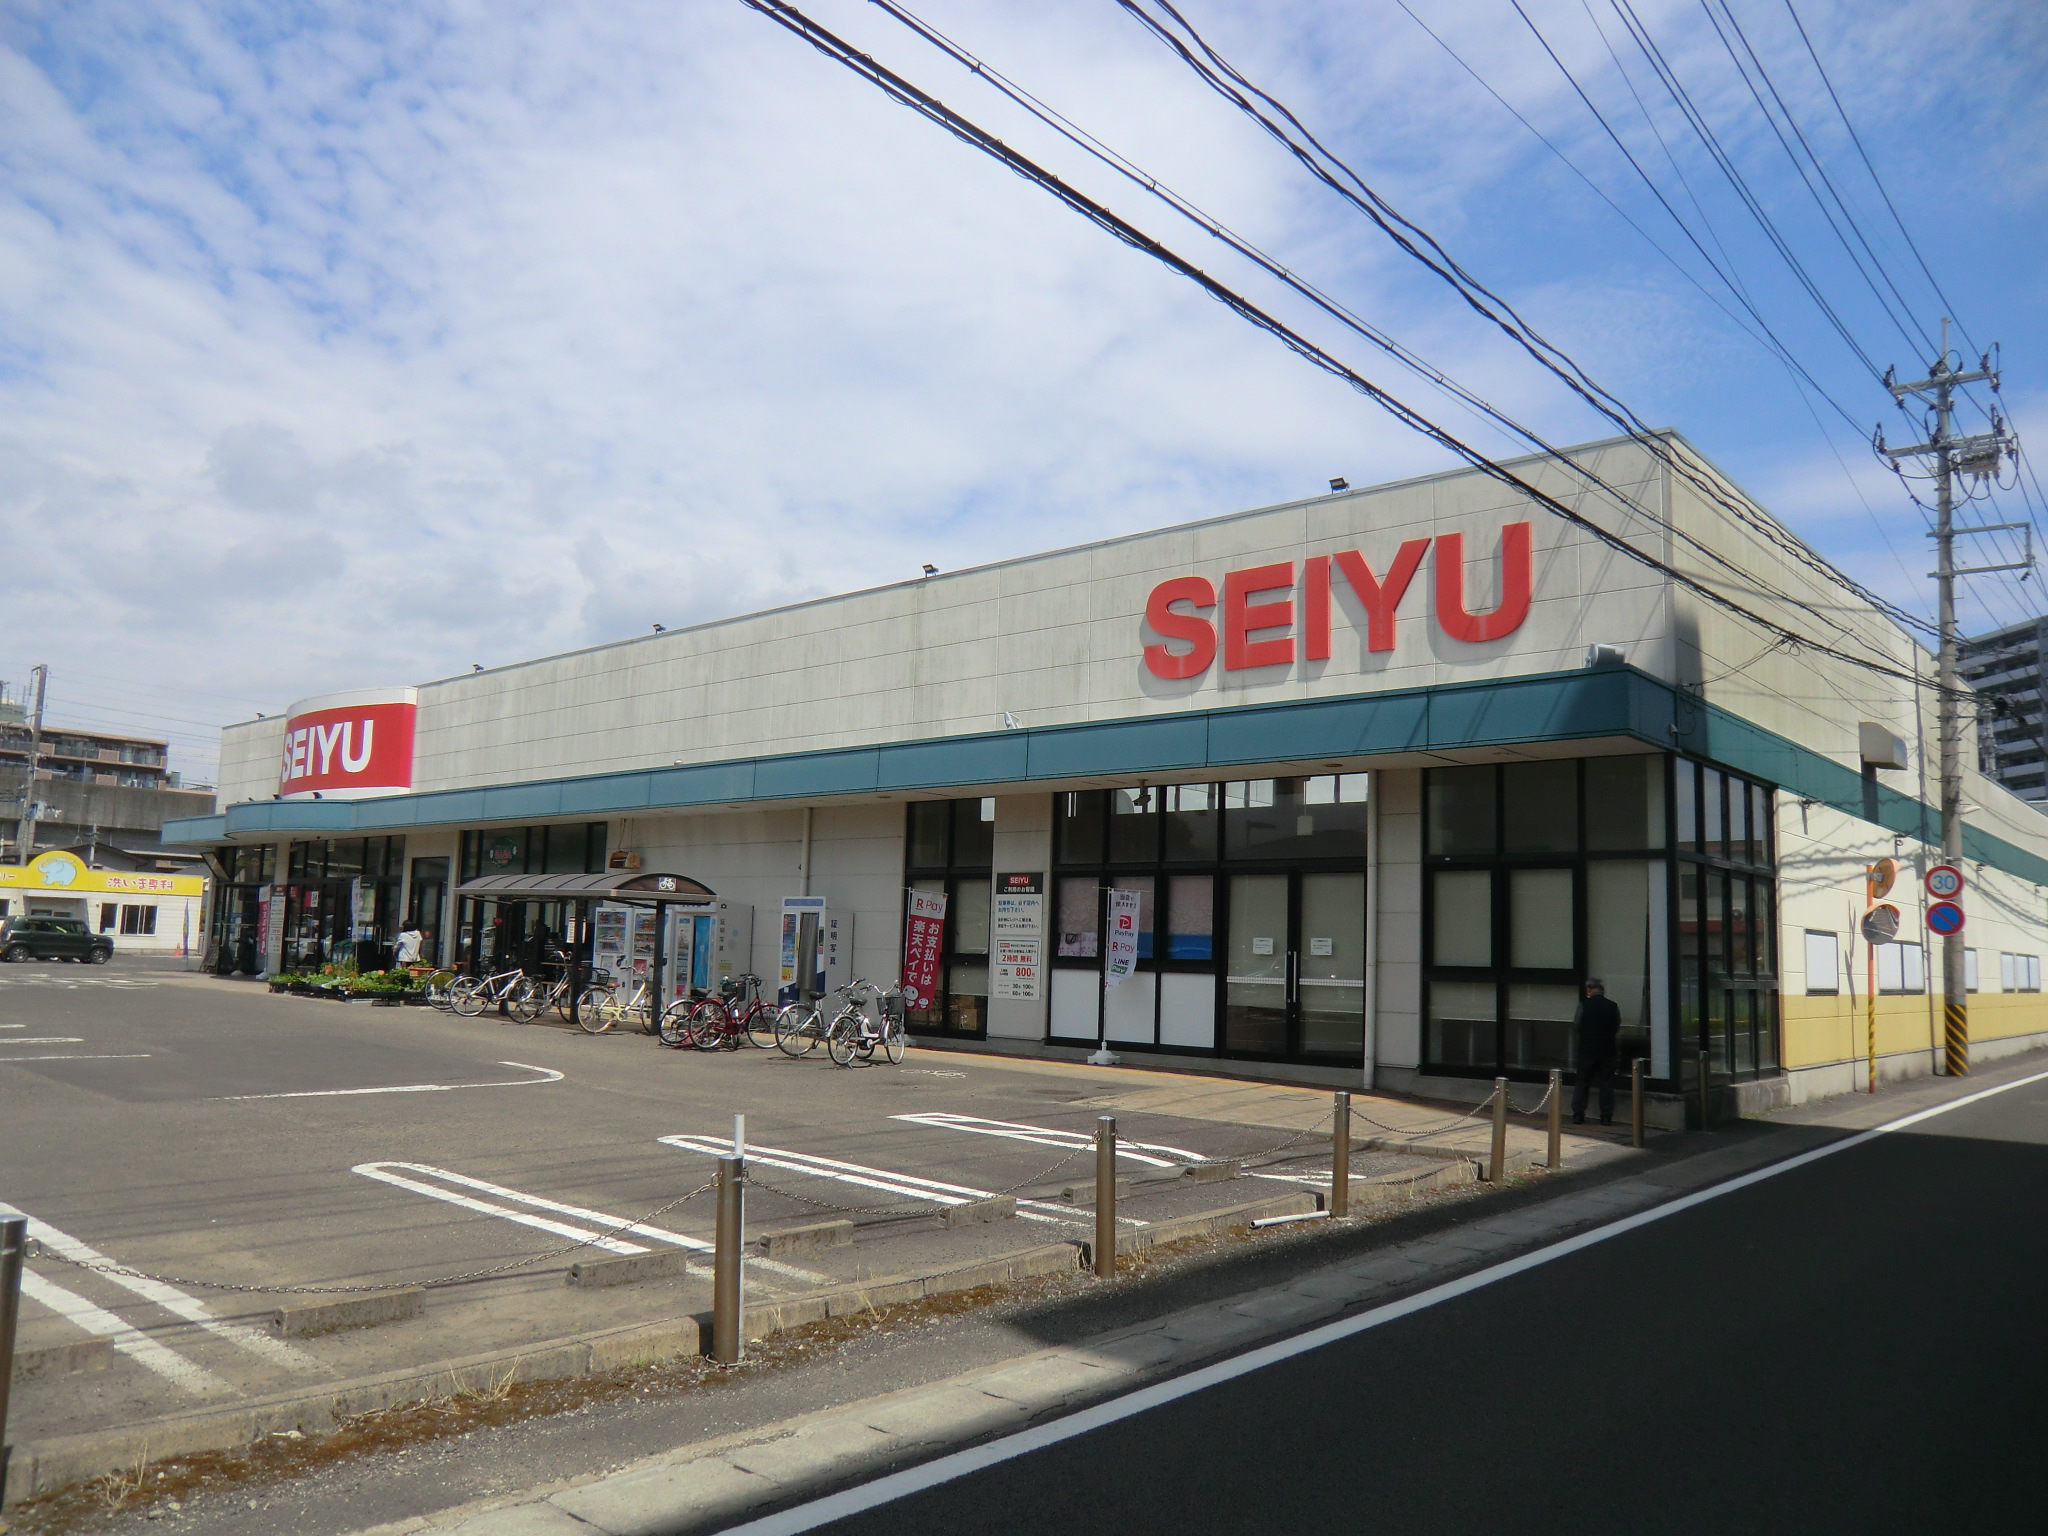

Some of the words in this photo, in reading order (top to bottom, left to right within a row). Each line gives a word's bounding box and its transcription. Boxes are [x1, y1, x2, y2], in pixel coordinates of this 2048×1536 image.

[1144, 521, 1530, 680] SEIYU
[281, 719, 374, 783] SEIYU
[1010, 876, 1029, 884] SEIYU
[1933, 875, 1955, 890] 30
[916, 898, 924, 909] R
[926, 899, 943, 913] Pay
[719, 918, 727, 952] 証明写真
[1114, 929, 1134, 938] PayPay
[829, 919, 838, 965] 証明写真
[1120, 942, 1136, 954] Pay
[907, 919, 926, 983] 楽天ペイで
[920, 922, 939, 985] お支払いは
[1002, 954, 1018, 962] 2時間
[1020, 955, 1032, 963] 無料
[1113, 957, 1130, 966] LINE
